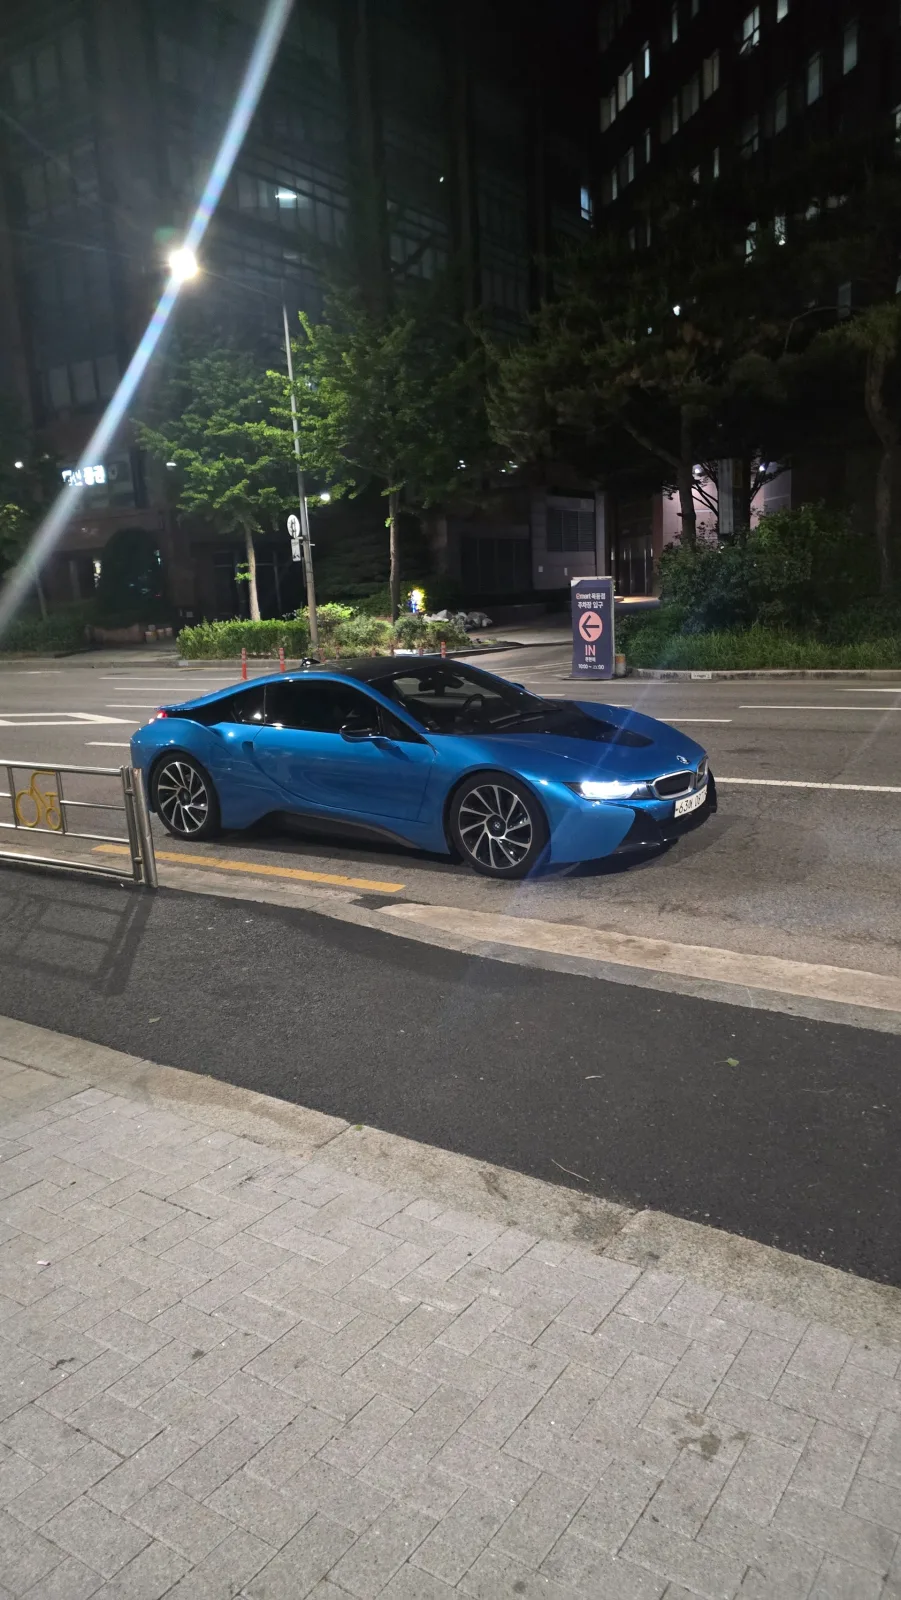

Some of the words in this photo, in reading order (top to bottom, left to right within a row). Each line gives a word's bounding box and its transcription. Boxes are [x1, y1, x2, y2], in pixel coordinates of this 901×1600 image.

[577, 601, 592, 609] 주차장
[592, 601, 604, 609] 입구
[585, 644, 596, 656] IN
